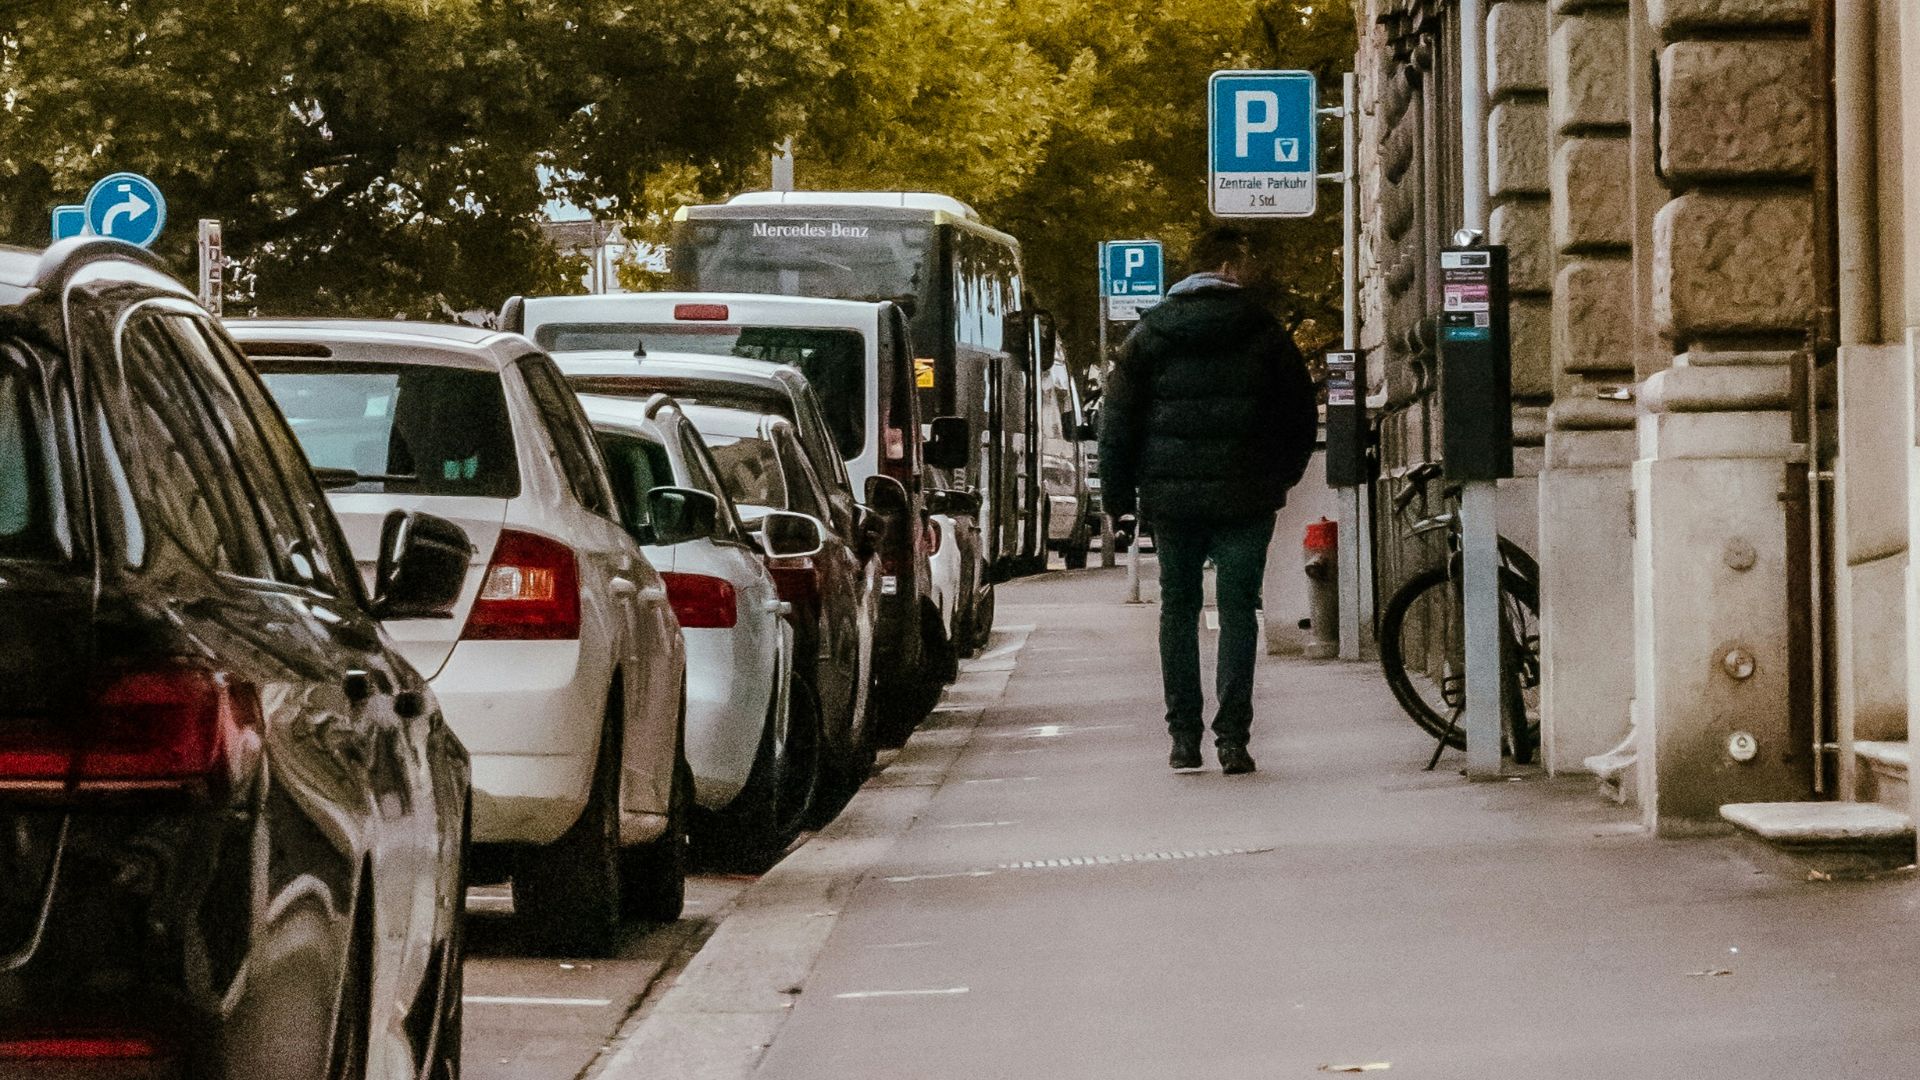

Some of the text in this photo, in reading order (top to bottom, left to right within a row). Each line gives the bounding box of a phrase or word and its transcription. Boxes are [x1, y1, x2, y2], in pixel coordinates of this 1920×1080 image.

[1235, 90, 1279, 158] P
[1219, 176, 1308, 189] Zentrale Parkuhr
[1250, 194, 1278, 207] 2 Std.
[752, 222, 870, 239] Mercedes-Benz
[1124, 248, 1145, 278] P
